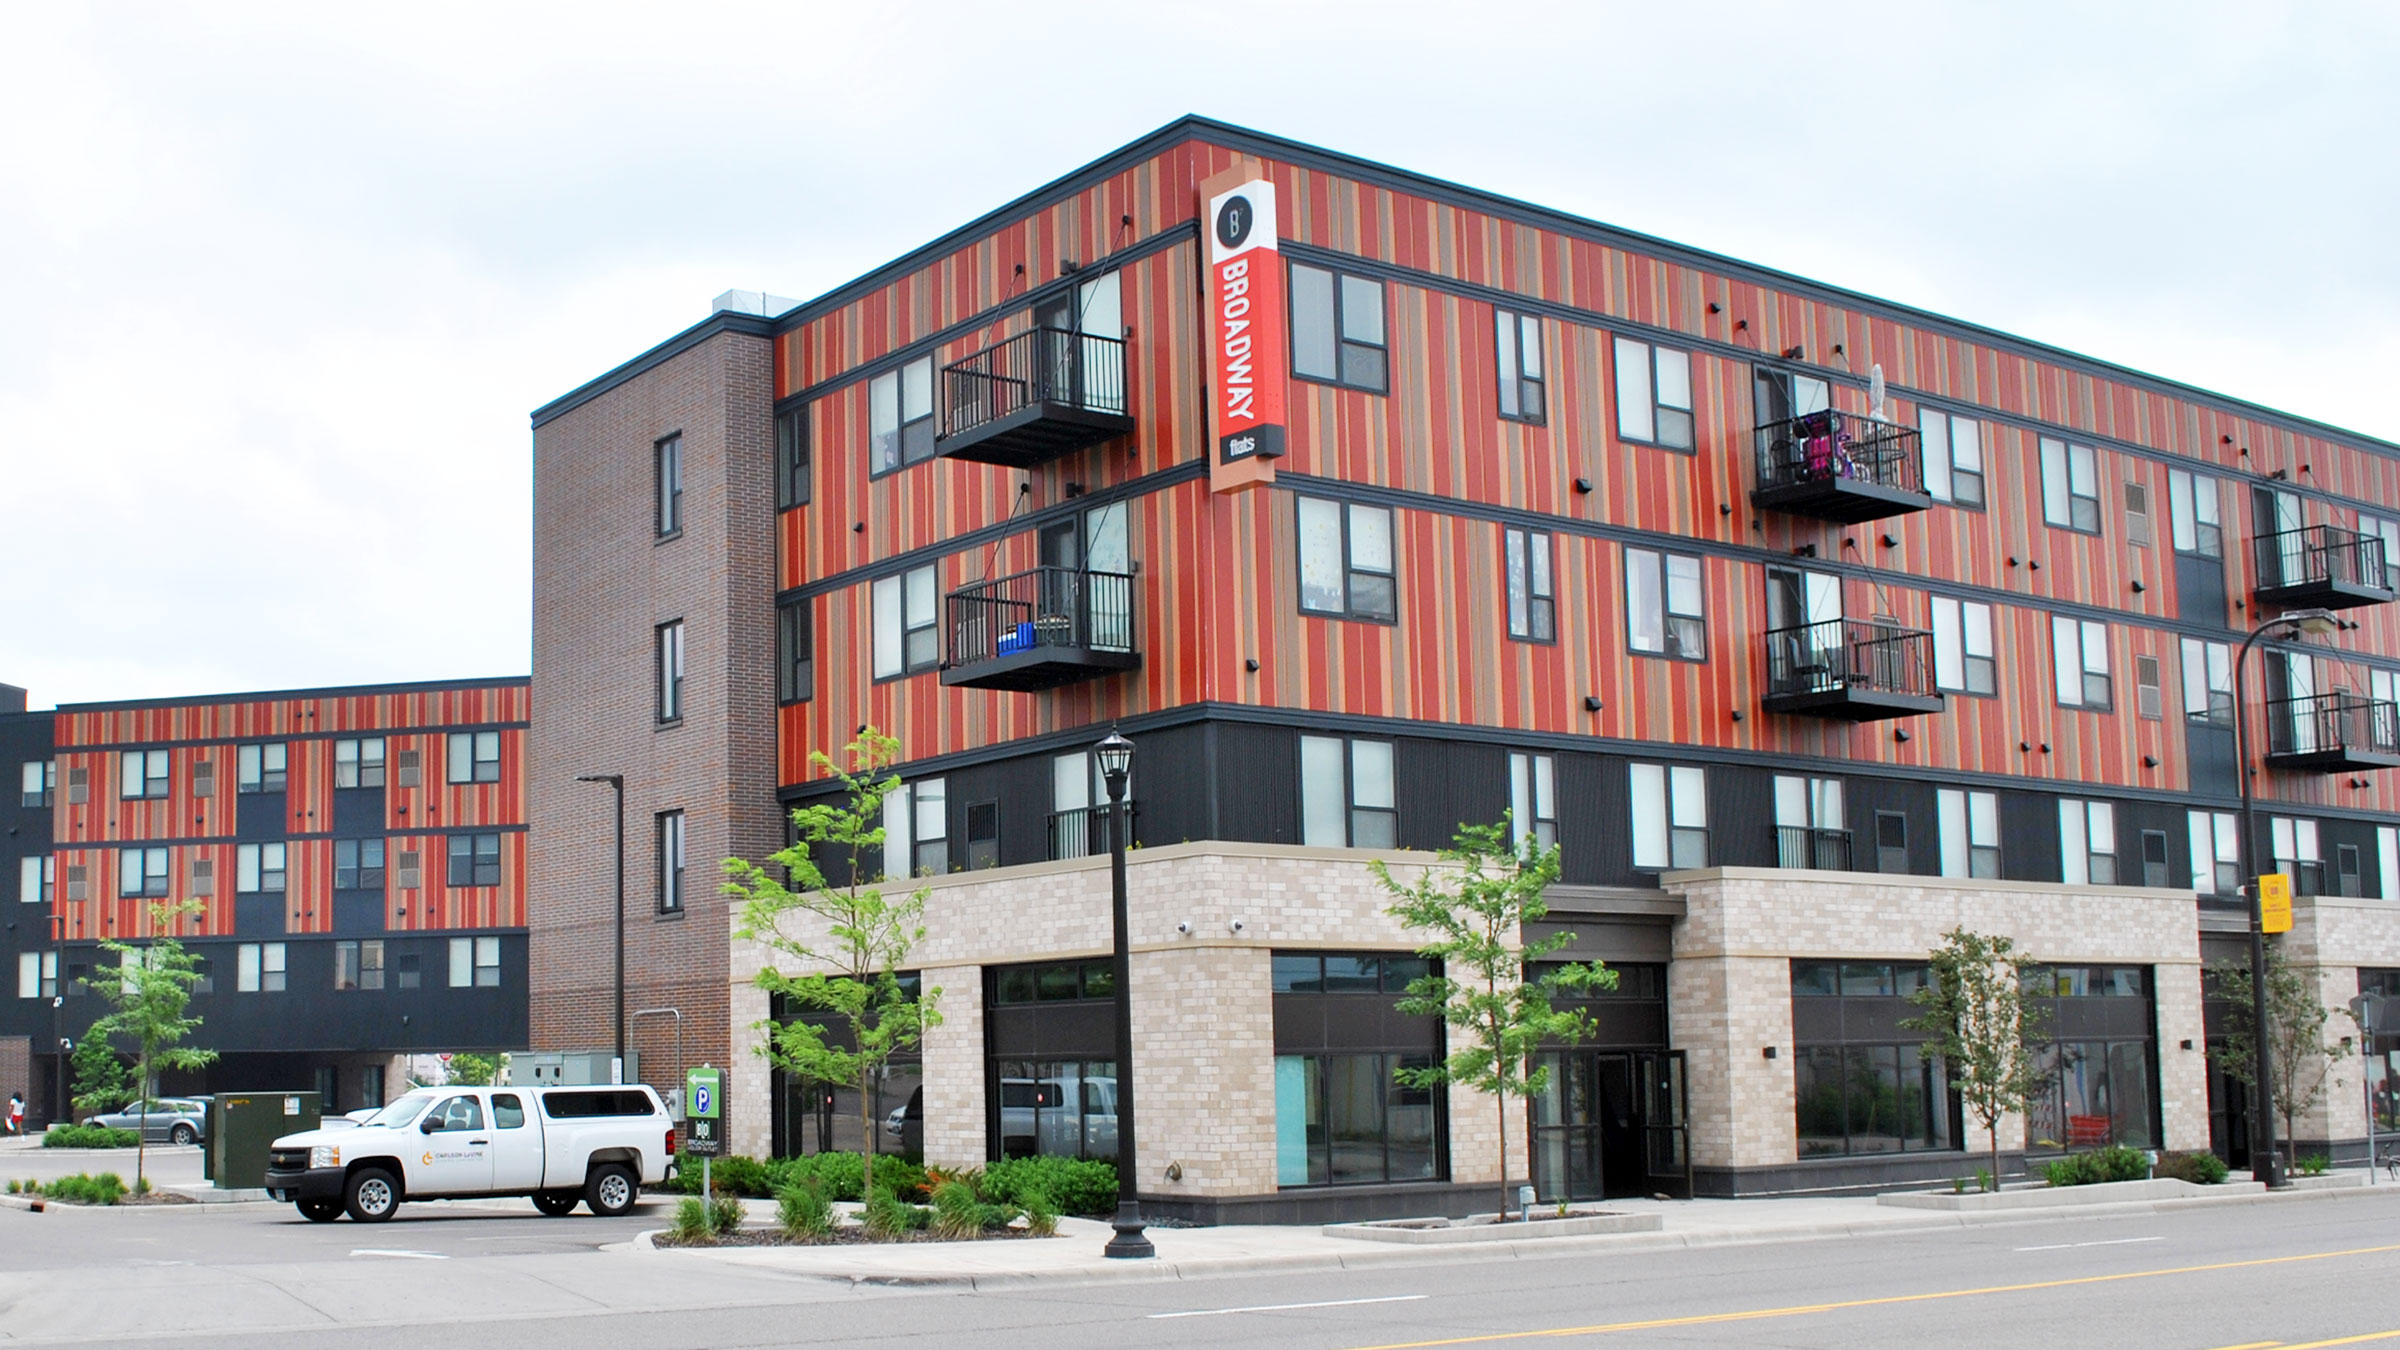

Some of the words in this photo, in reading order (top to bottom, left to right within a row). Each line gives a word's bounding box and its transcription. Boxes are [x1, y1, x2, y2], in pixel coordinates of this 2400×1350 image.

[1230, 209, 1240, 238] B
[1222, 257, 1255, 420] BROADWAY
[1229, 436, 1256, 457] flats
[698, 1089, 708, 1111] P
